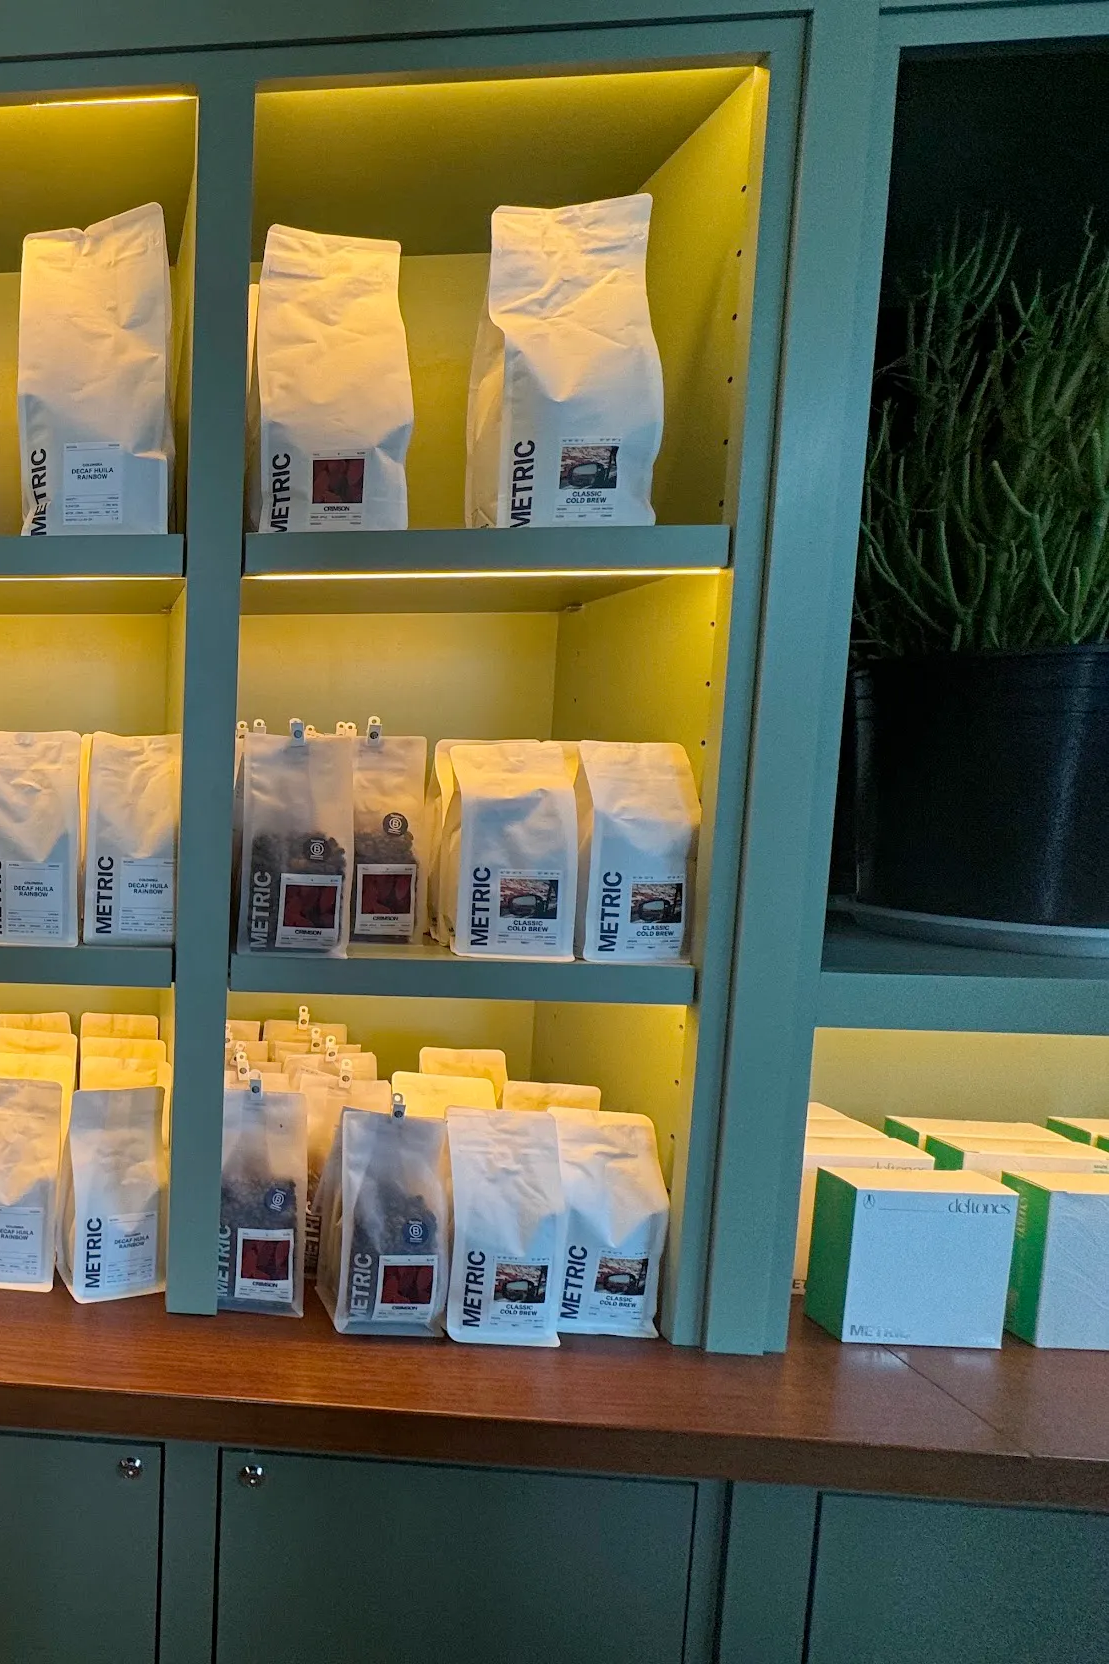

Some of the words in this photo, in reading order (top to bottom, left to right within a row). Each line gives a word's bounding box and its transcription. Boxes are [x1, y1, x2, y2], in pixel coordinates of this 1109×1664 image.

[31, 448, 47, 536] METRIC
[271, 453, 291, 532] METRIC
[510, 440, 536, 528] METRIC
[96, 856, 114, 934] METRIC
[250, 871, 272, 948] METRIC
[470, 867, 491, 945] METRIC
[598, 872, 622, 952] METRIC
[948, 1198, 1011, 1214] deftones
[85, 1217, 102, 1288] METRIC
[118, 1241, 145, 1249] RAINBOW
[217, 1225, 232, 1297] METRIC
[559, 1245, 588, 1319] METRIC
[349, 1253, 373, 1319] METRIC
[462, 1251, 486, 1327] METRIC
